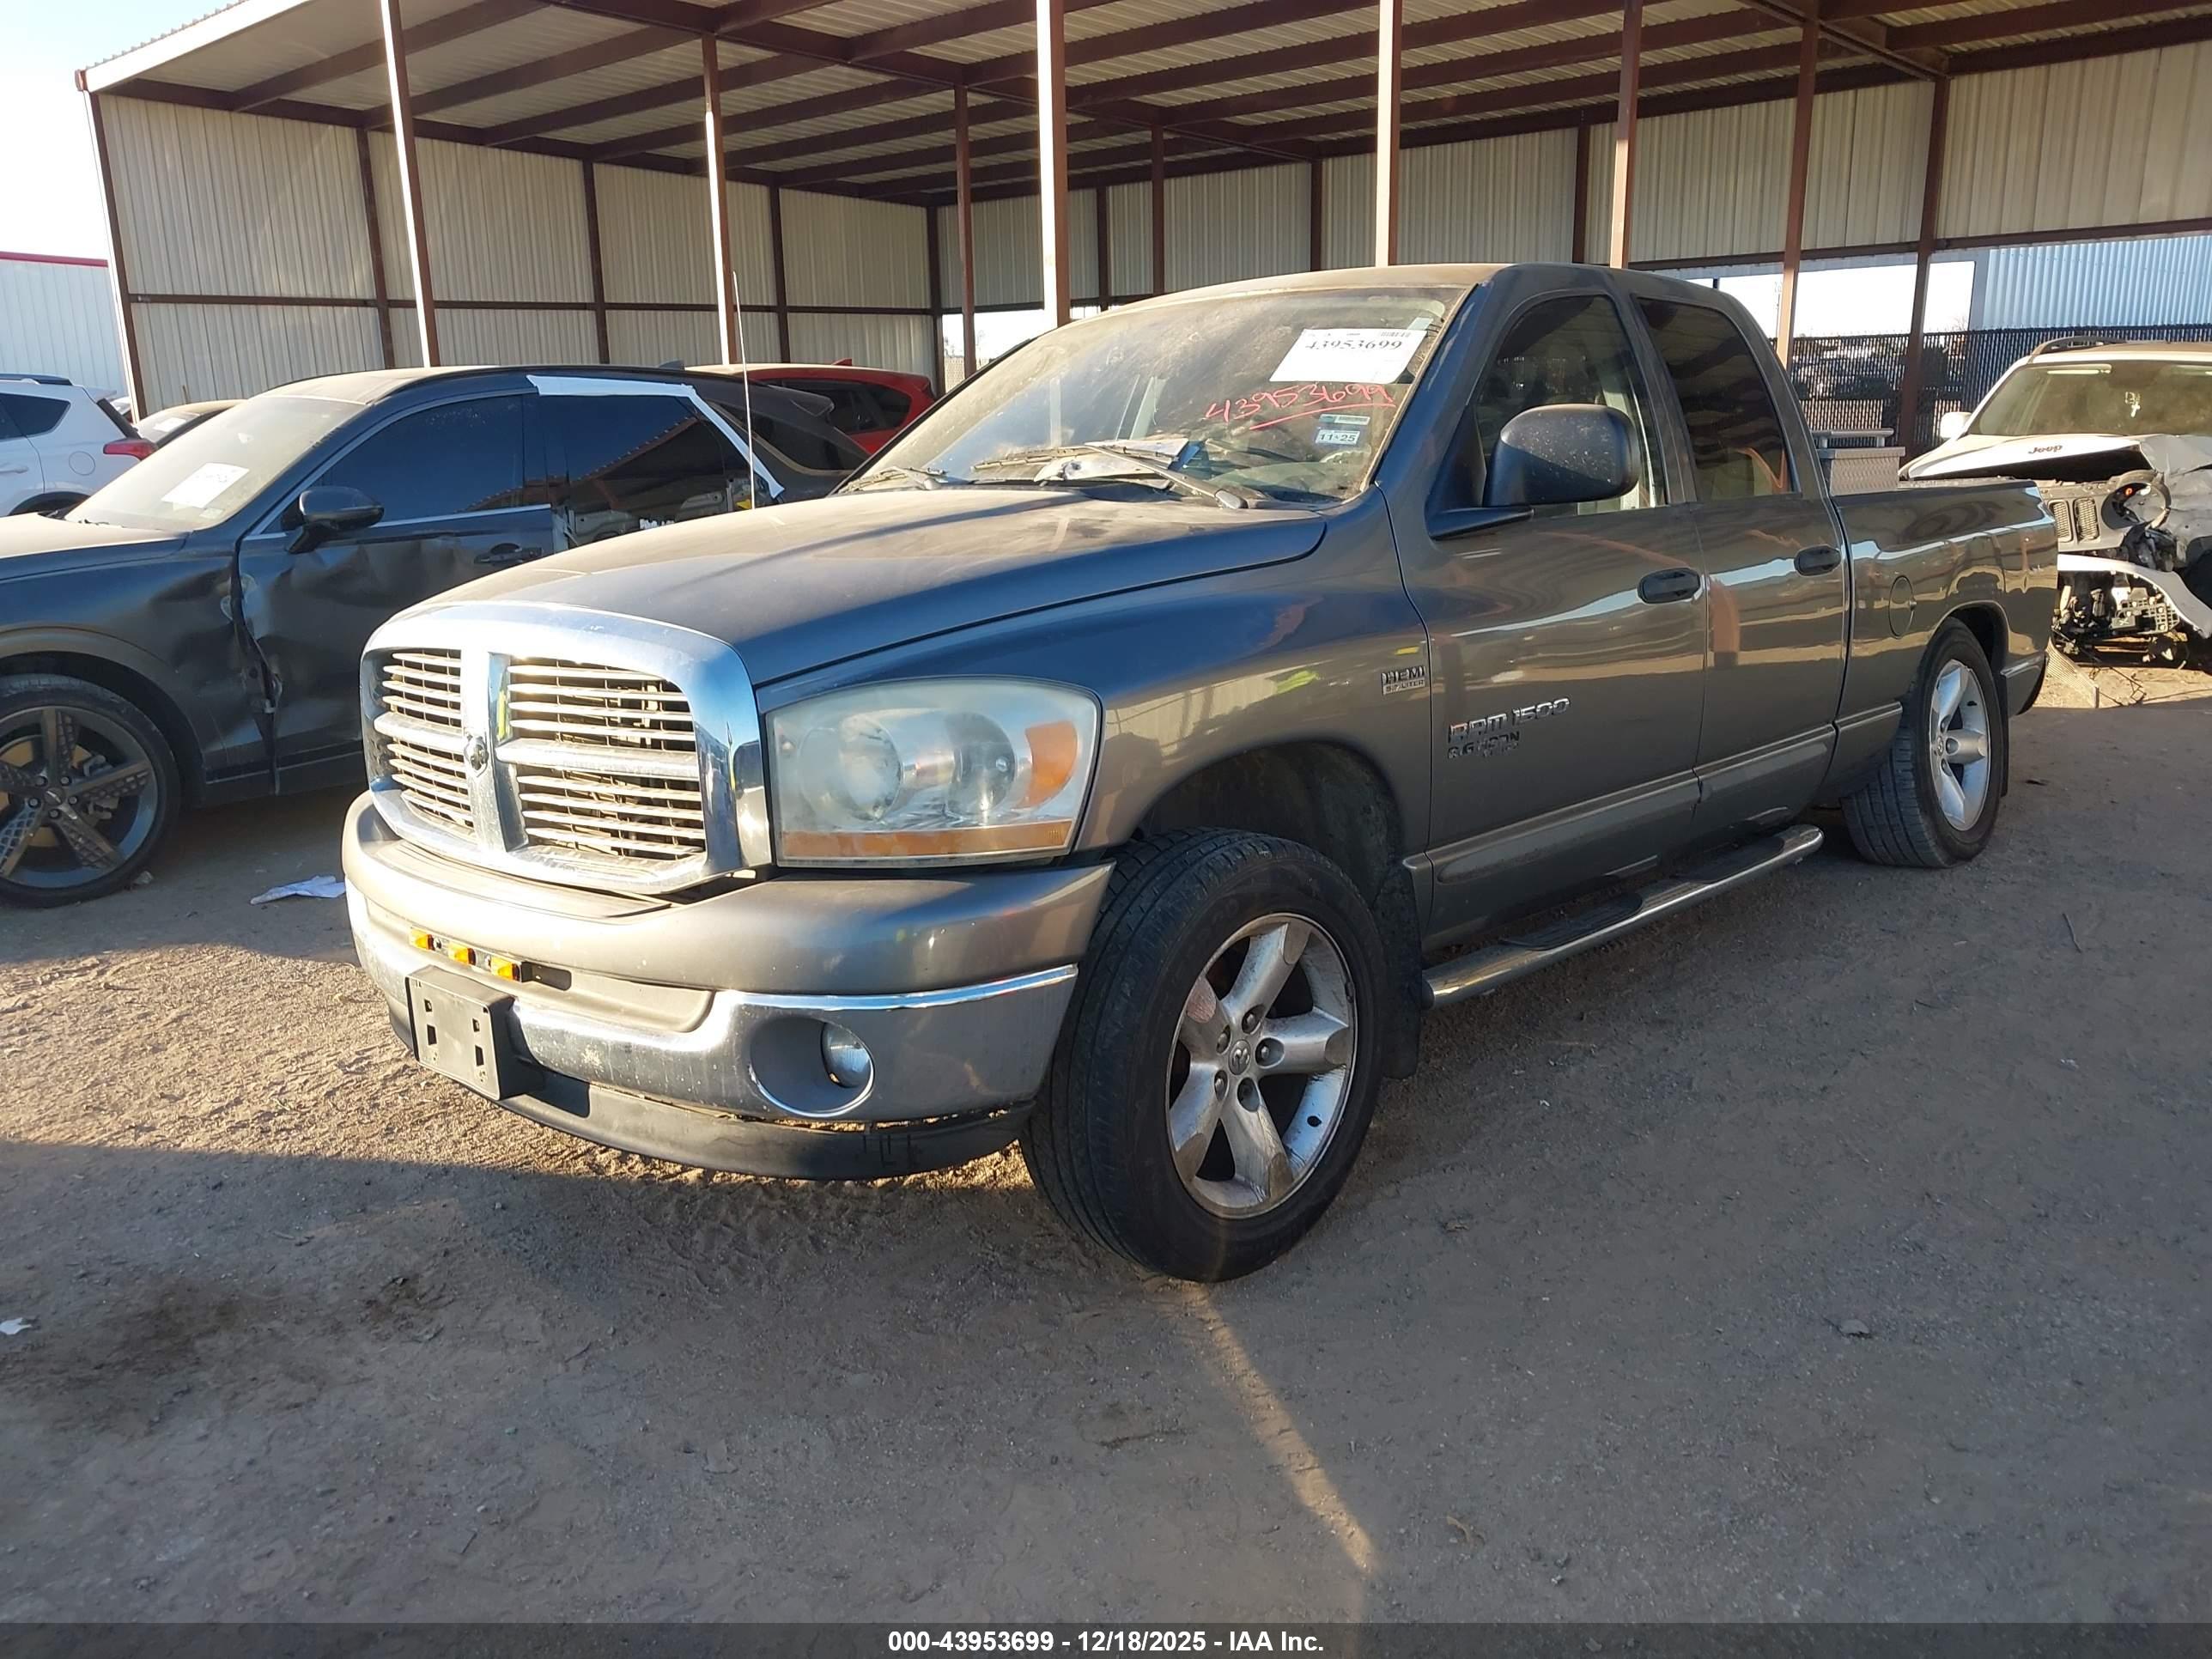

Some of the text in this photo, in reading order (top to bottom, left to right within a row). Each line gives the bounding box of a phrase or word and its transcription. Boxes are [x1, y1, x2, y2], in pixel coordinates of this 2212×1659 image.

[1305, 339, 1402, 350] 43953699
[1205, 383, 1394, 422] 43953699
[2027, 445, 2063, 453] Jeep
[1381, 665, 1426, 684] HEMI
[1449, 697, 1571, 743] RAM 1500
